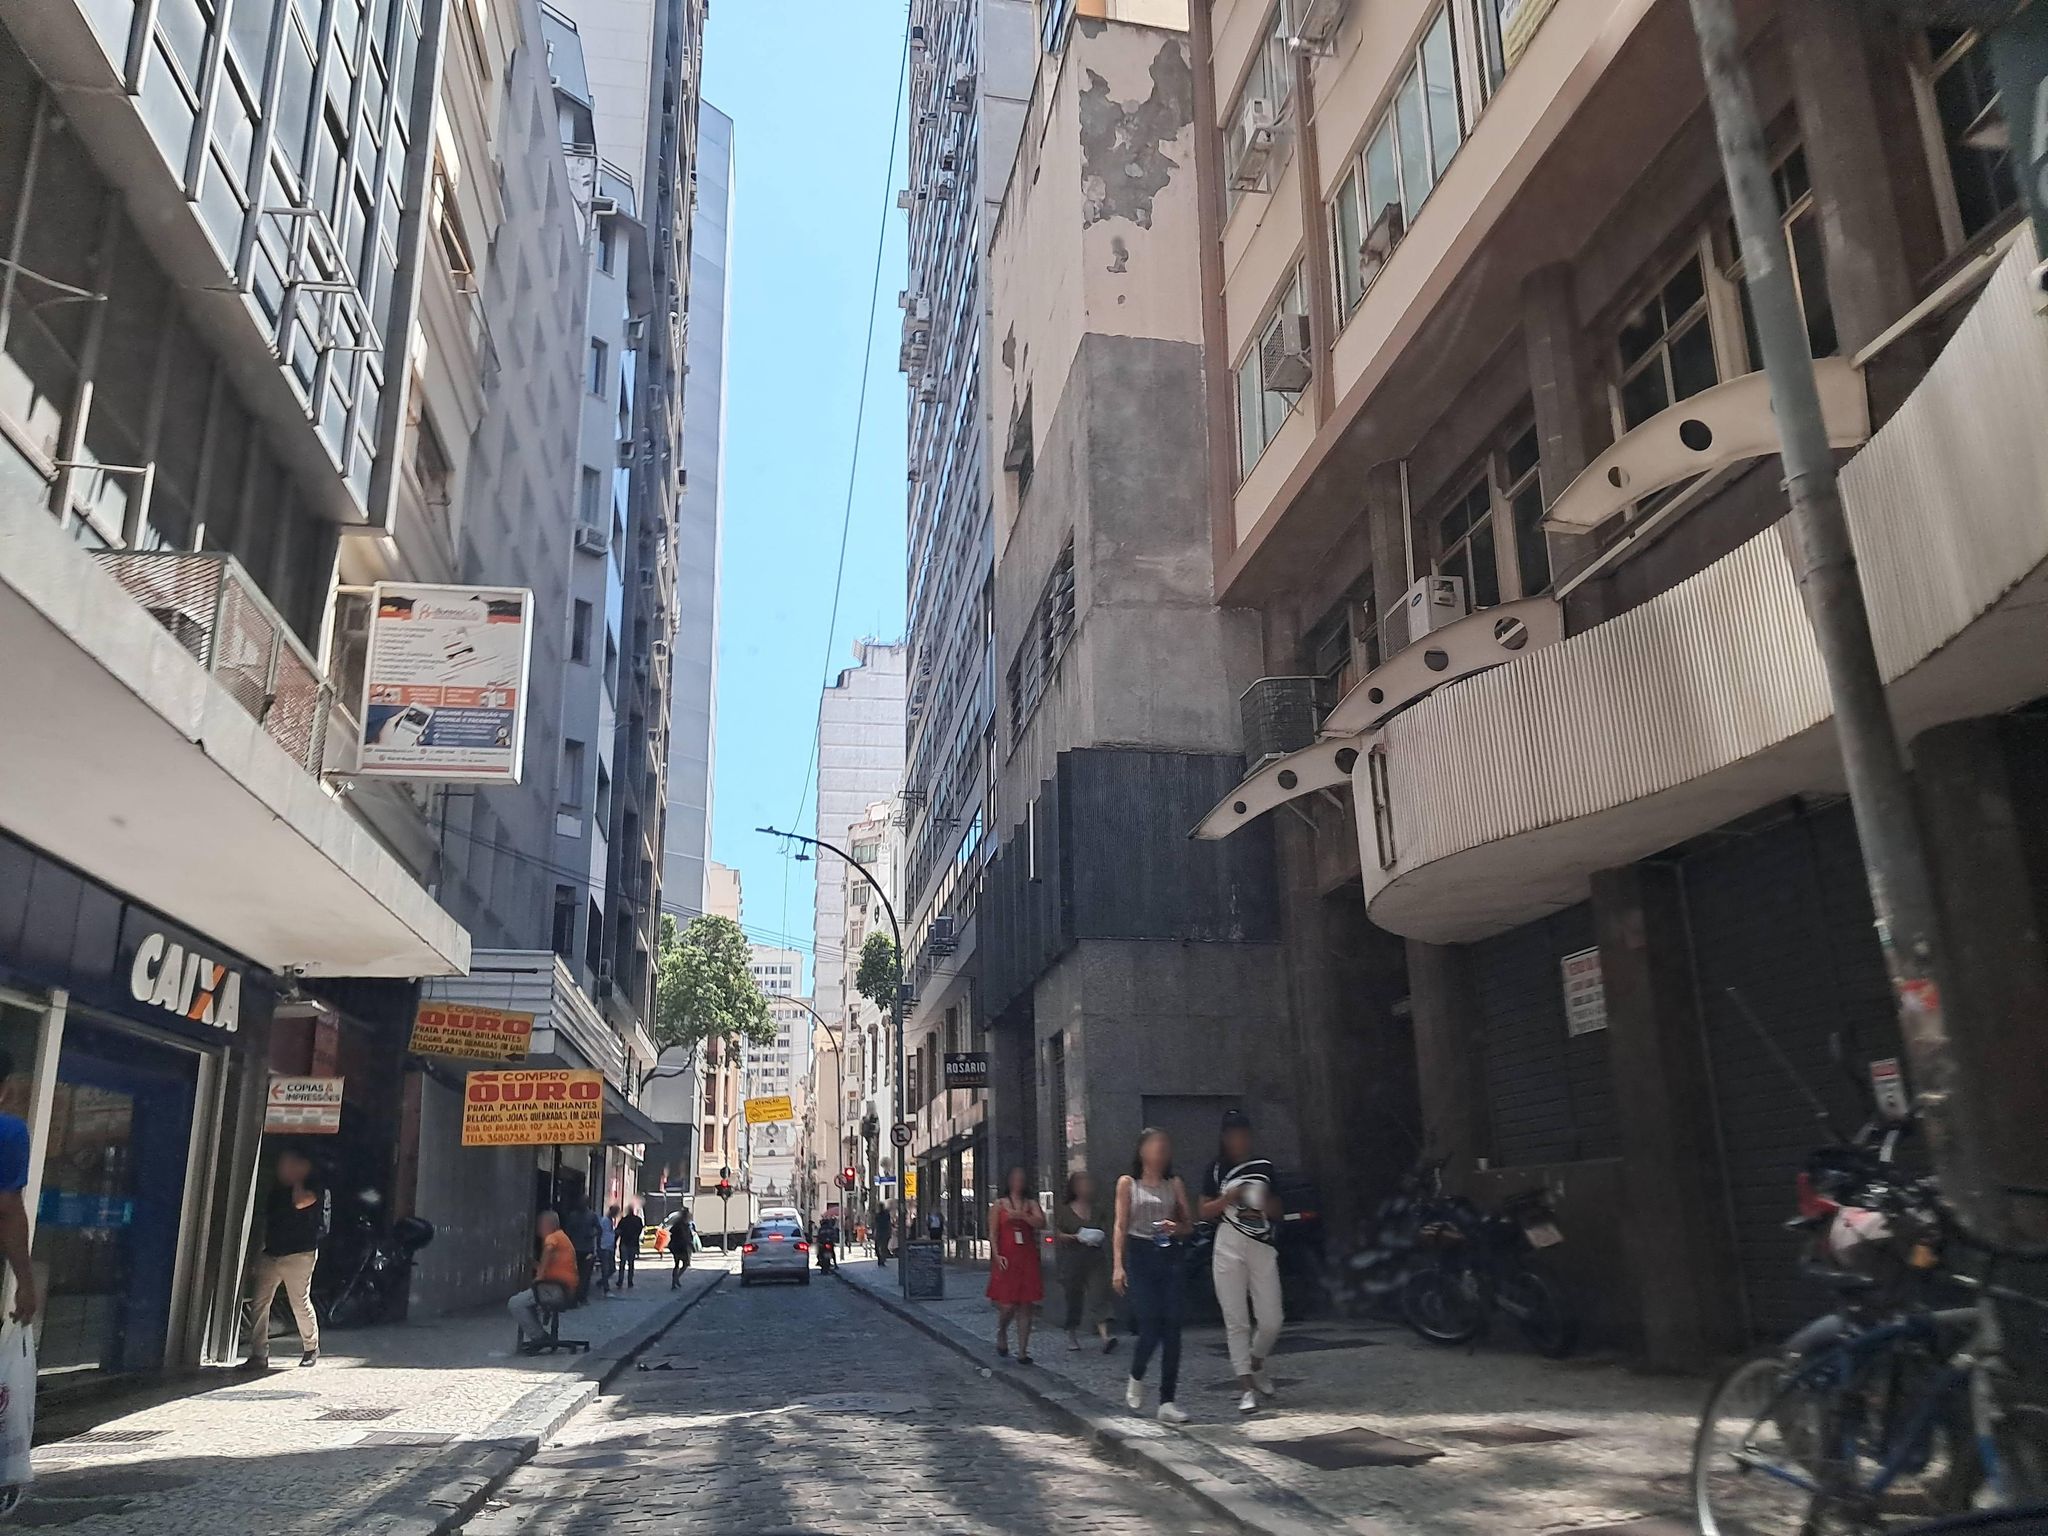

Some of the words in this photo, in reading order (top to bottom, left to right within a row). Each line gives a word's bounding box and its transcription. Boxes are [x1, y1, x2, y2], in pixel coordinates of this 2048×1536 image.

[131, 932, 241, 1032] CAIXA
[446, 1005, 503, 1017] COMPRO
[418, 1011, 531, 1035] OURO
[415, 1025, 439, 1034] PRATA
[442, 1028, 472, 1038] PLATINA
[475, 1031, 521, 1043] BRILHANTES
[503, 1072, 569, 1081] COMPRO
[469, 1082, 600, 1102] OURO
[467, 1104, 494, 1112] PRATA
[500, 1102, 538, 1111] PLATINA
[543, 1101, 597, 1110] BRILHANTES
[530, 1111, 567, 1121] QUEBRADAS
[570, 1111, 579, 1120] EM
[581, 1110, 600, 1119] GERAL
[483, 1124, 492, 1132] DO
[548, 1121, 573, 1130] SALA
[578, 1121, 596, 1130] 302
[487, 1133, 530, 1142] 35807382
